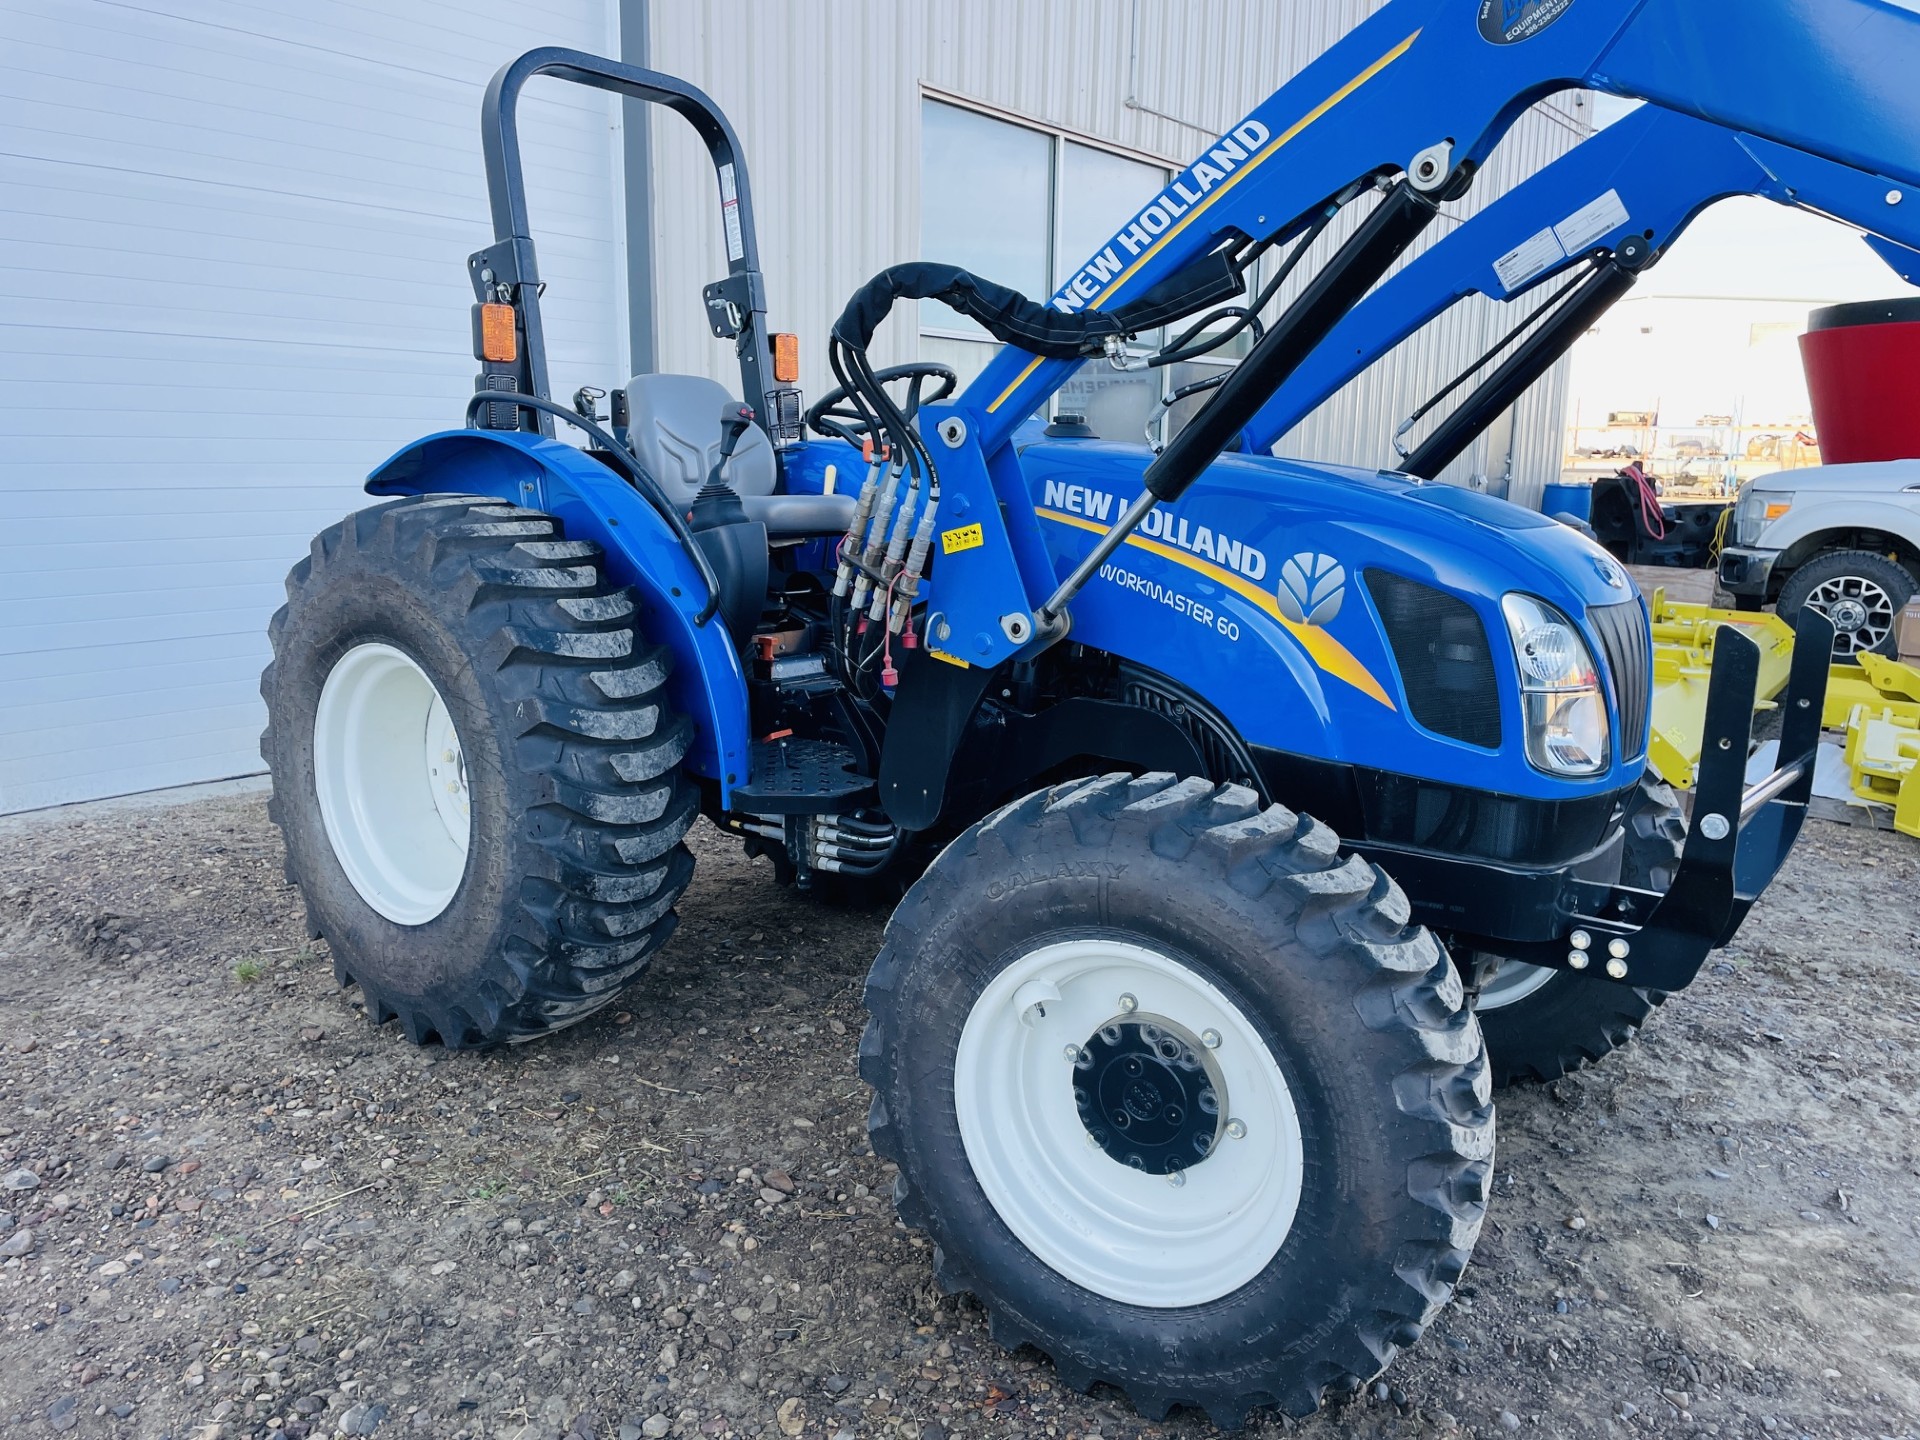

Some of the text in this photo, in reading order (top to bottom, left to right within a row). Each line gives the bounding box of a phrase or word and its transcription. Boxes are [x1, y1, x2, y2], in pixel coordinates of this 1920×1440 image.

[1505, 0, 1559, 41] EQUIPMENT
[1052, 119, 1271, 314] NEW HOLLAND
[1043, 479, 1113, 521] NEW
[1099, 563, 1240, 642] WORKMASTER 60
[986, 860, 1129, 900] GALAXY
